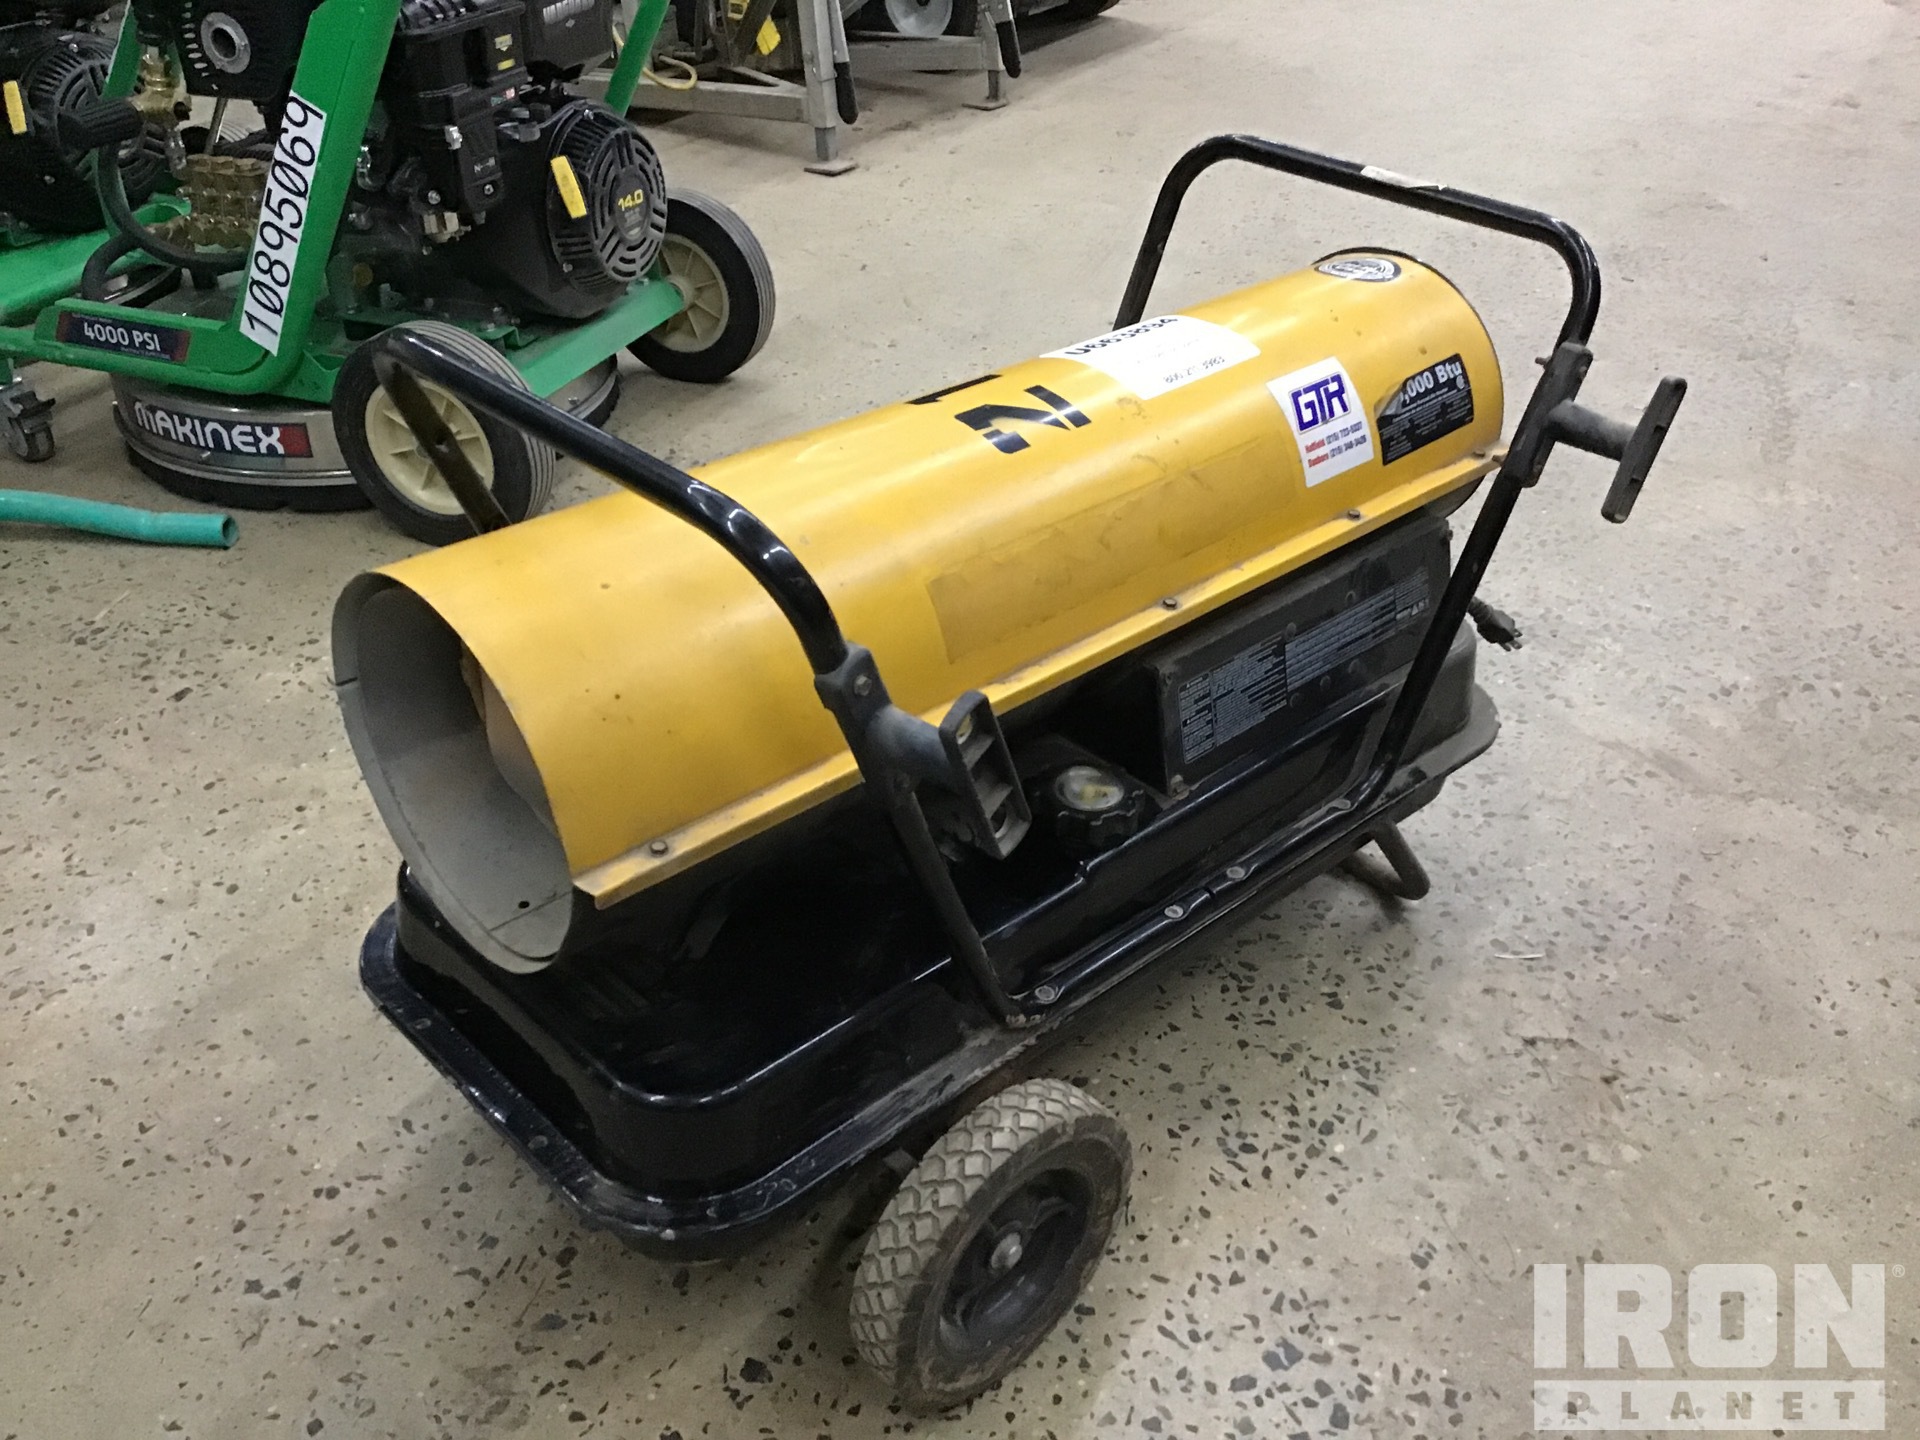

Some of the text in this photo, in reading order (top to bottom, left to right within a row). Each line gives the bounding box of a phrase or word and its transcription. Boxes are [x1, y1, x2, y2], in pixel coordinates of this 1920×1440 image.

[244, 96, 324, 336] 10895069
[617, 188, 644, 212] 14.0
[83, 321, 161, 352] 4000 PSI
[1434, 361, 1463, 384] Btu
[1290, 373, 1349, 432] GTR
[133, 401, 285, 455] MAKINEX
